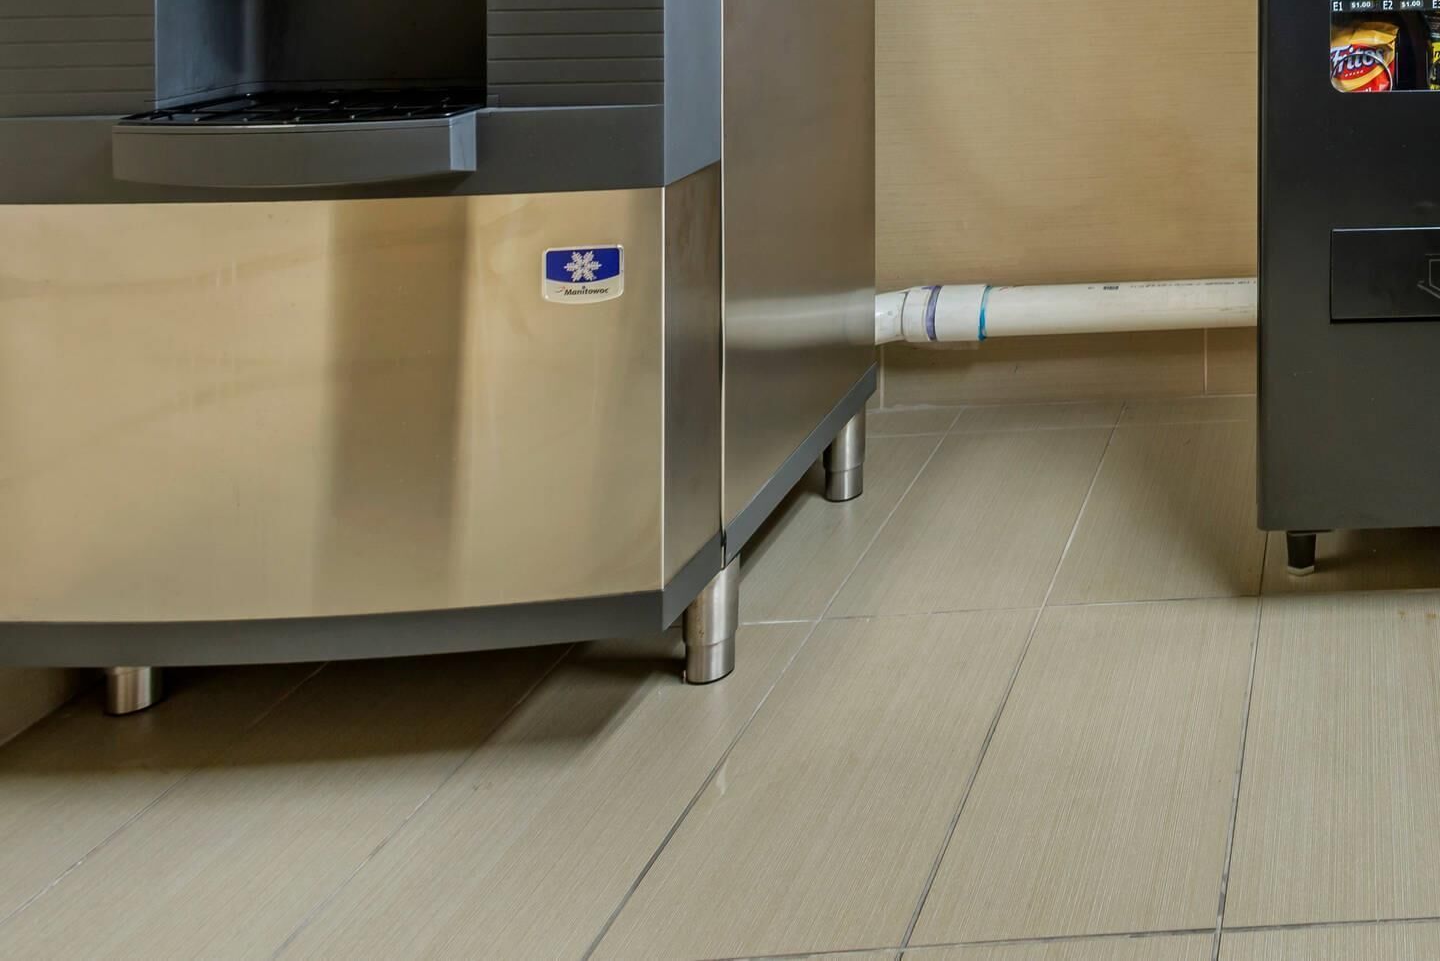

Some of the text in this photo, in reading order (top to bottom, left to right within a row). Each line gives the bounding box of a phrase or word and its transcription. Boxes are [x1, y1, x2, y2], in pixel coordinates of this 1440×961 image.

[1333, 1, 1343, 12] E1
[1382, 0, 1421, 10] E2 $1.00
[1330, 45, 1385, 75] Fritos
[564, 286, 609, 296] Manitowoc
